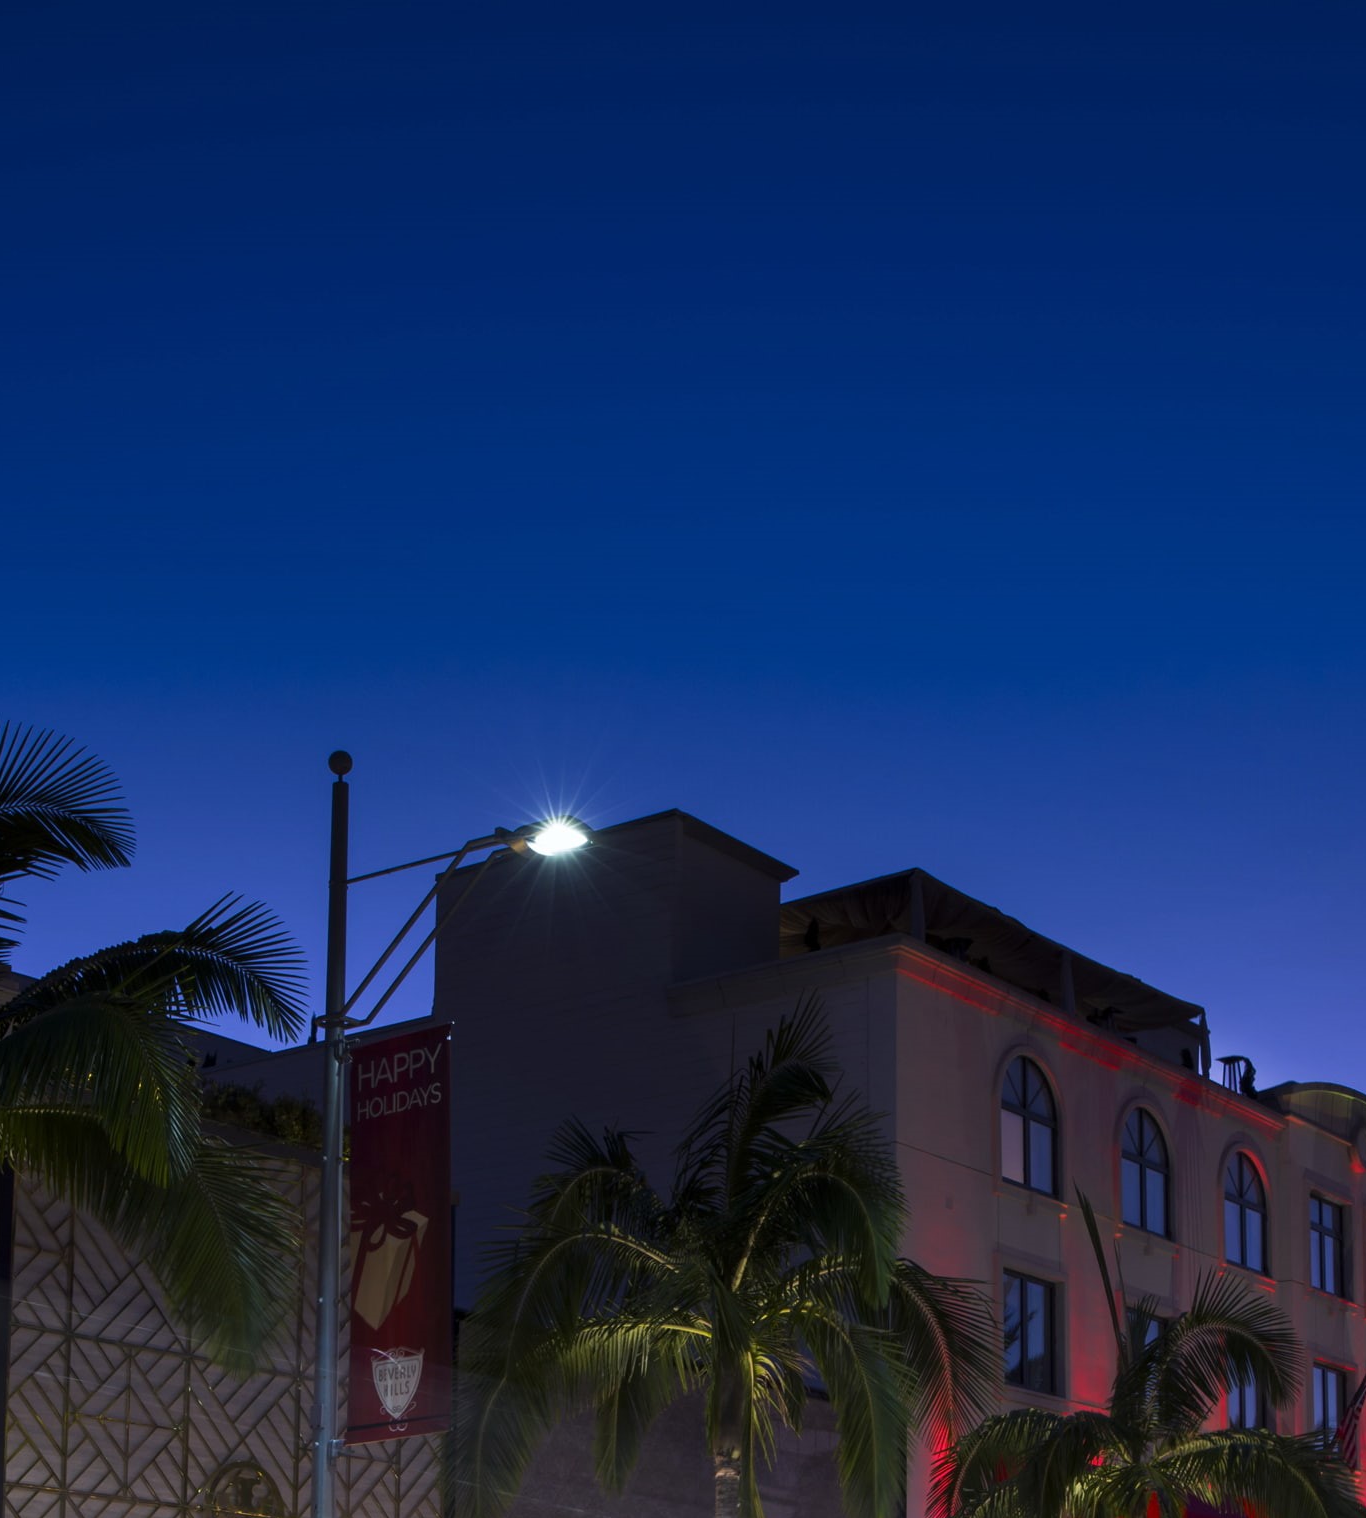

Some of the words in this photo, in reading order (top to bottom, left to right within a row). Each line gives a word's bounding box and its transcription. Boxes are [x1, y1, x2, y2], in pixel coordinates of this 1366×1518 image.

[358, 1042, 442, 1092] HAPPY
[357, 1082, 442, 1123] HOLIDAYS
[378, 1365, 417, 1382] BEVERLY
[383, 1381, 410, 1397] HILLS
